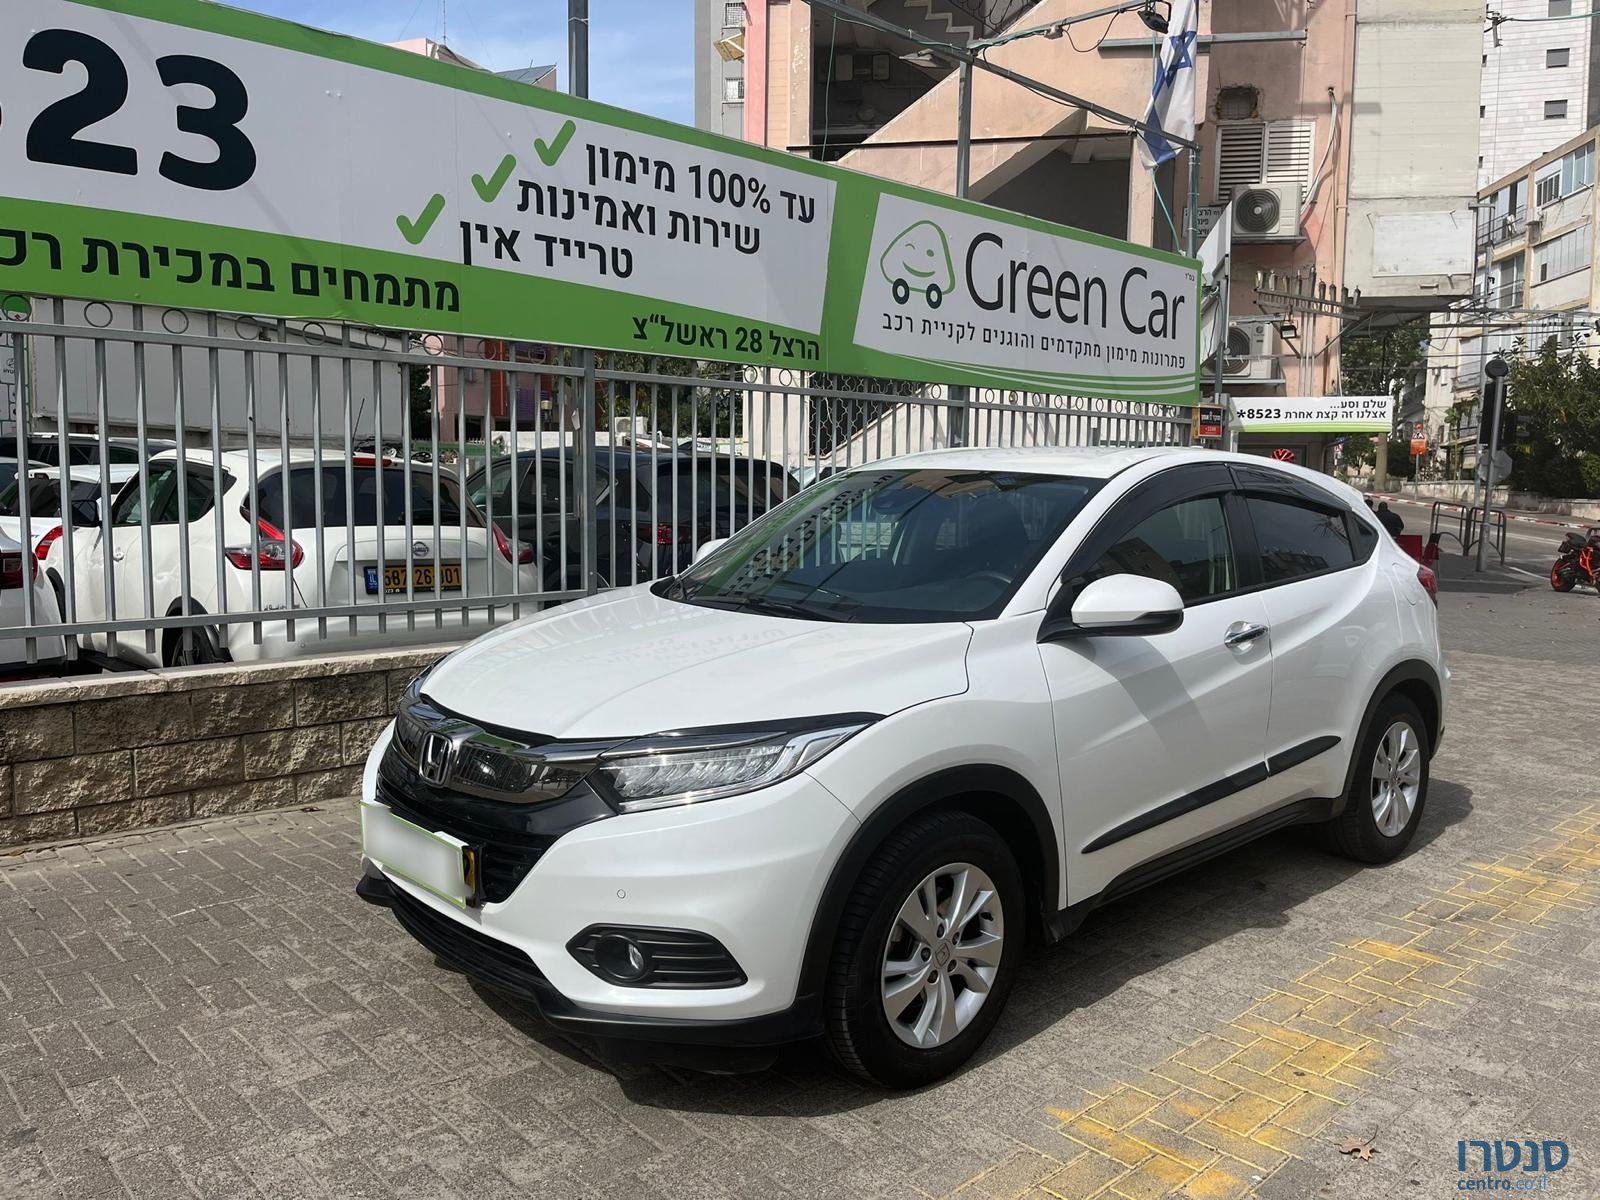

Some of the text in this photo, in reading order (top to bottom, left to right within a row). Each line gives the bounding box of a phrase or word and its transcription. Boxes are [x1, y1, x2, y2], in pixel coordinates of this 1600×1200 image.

[0, 29, 256, 190] 23
[586, 143, 814, 224] עד 100% מימון
[517, 180, 760, 255] שירות ואמינות
[0, 229, 460, 312] מתמחים במכירת רכ
[460, 221, 634, 278] טרייד אין
[965, 232, 1185, 340] Green Car
[735, 327, 762, 355] 28
[769, 329, 820, 361] הרצל
[882, 312, 1185, 369] פתרונות מימון מתקדמים והוגנים לקניית רכב
[1284, 410, 1313, 419] אחרת
[1315, 411, 1338, 421] קצת
[1341, 410, 1354, 419] זה
[1356, 410, 1387, 420] אצלנו
[1362, 400, 1387, 409] שלם
